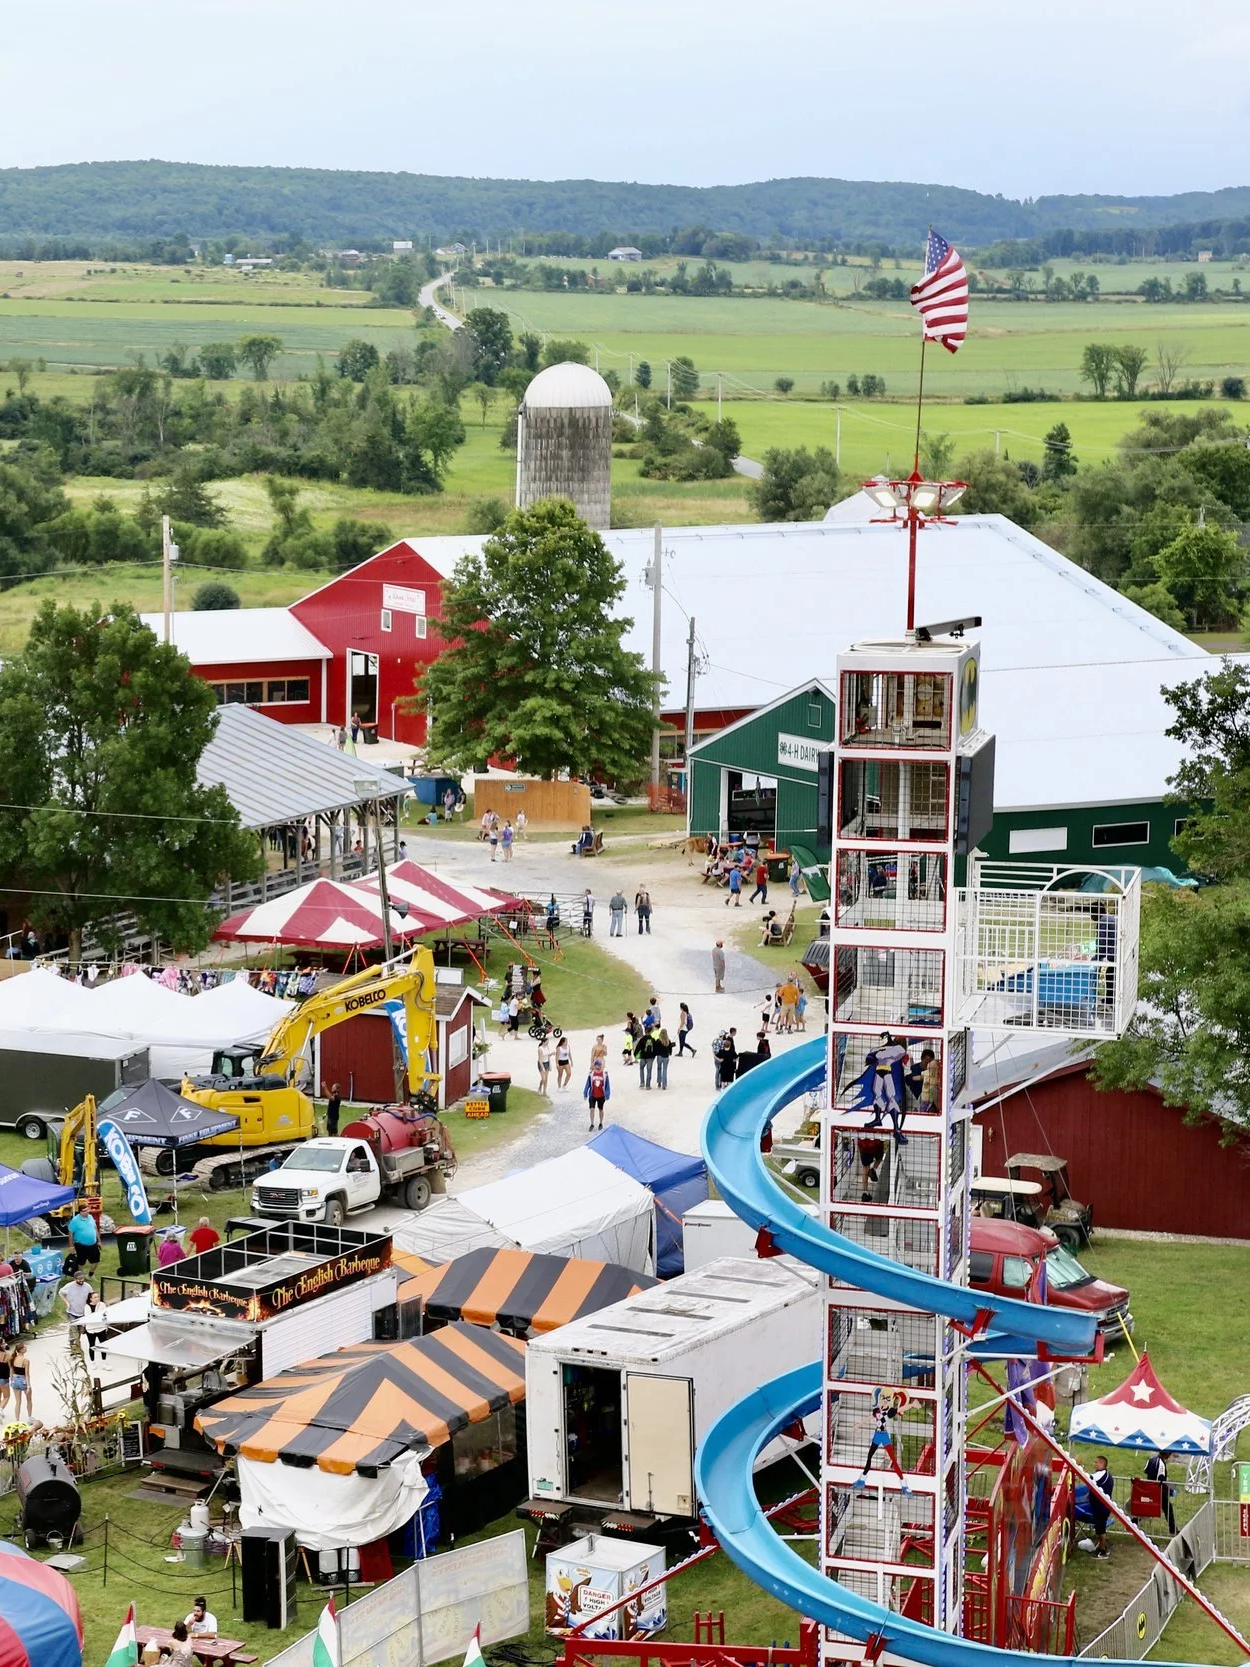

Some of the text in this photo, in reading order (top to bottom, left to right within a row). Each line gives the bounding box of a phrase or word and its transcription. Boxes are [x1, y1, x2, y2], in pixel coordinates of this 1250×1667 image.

[788, 743, 799, 758] 4-H
[344, 989, 386, 1012] KOBELCO
[124, 1110, 140, 1120] F
[180, 1108, 192, 1120] F
[272, 1256, 380, 1309] The English Barbeque
[159, 1280, 248, 1308] The English Barbeque
[583, 1589, 611, 1599] DANGER
